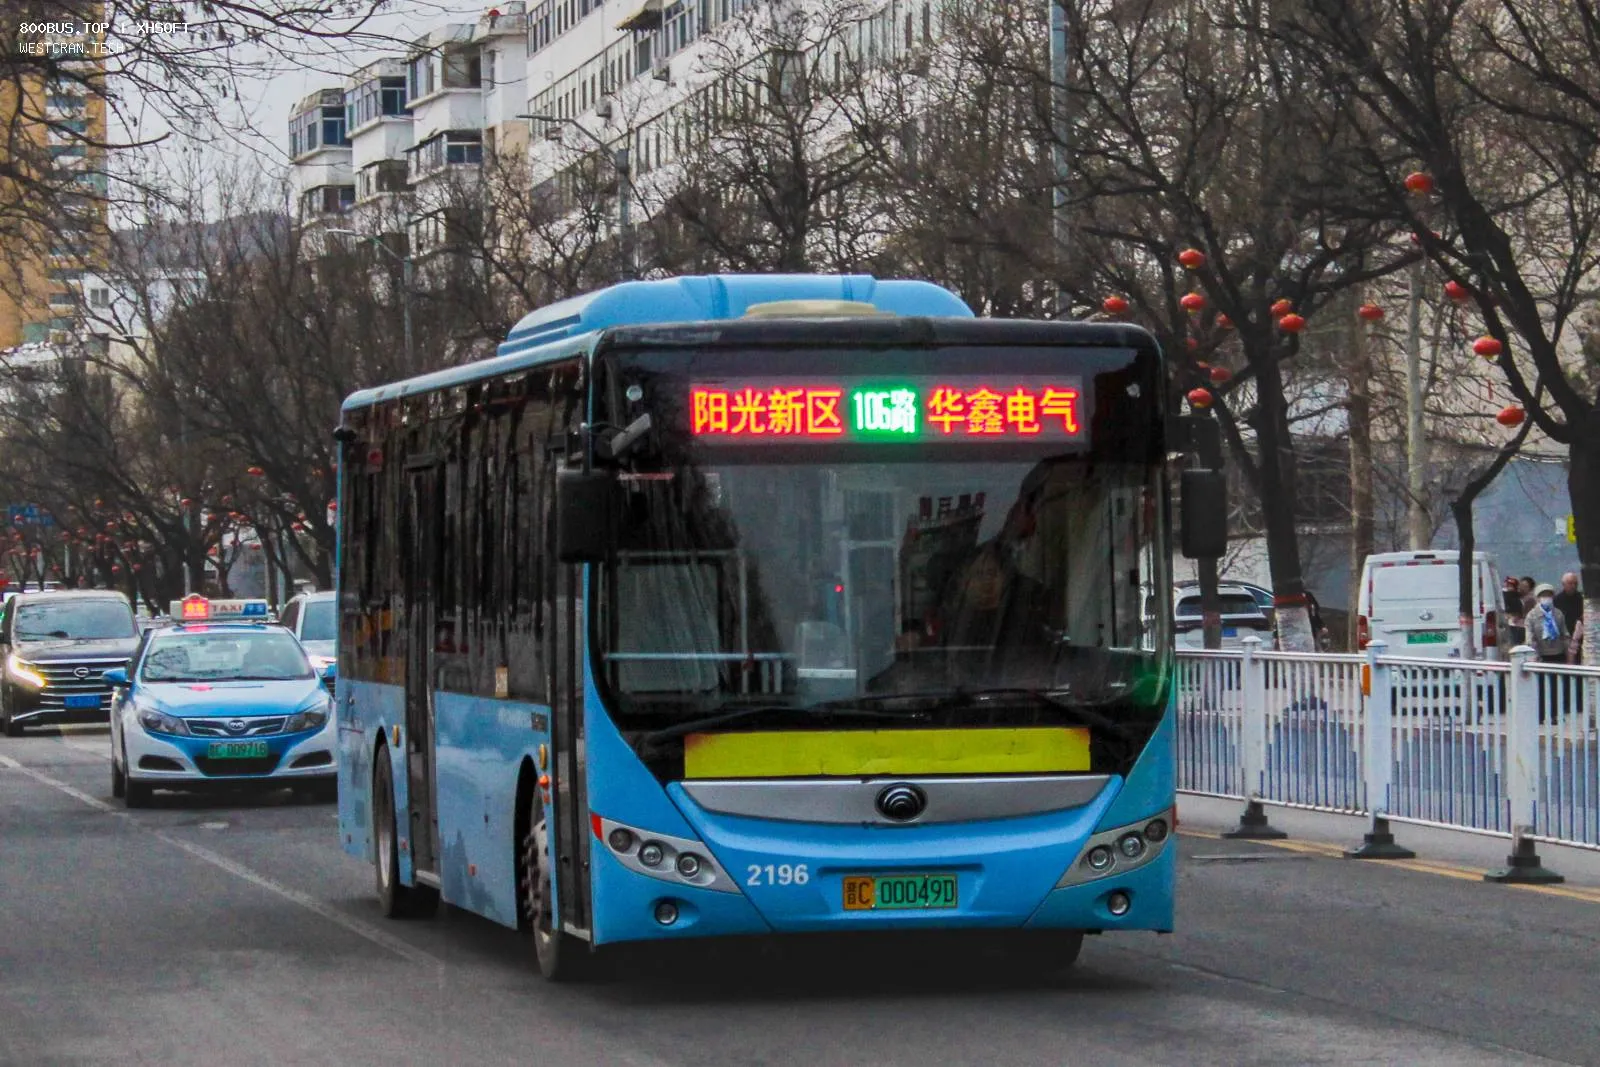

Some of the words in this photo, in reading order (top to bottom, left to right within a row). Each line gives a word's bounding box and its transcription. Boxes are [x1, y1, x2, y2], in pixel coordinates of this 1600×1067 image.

[692, 389, 843, 435] 阳光新区
[927, 388, 1078, 434] 华鑫电气
[212, 603, 242, 612] TAXI
[746, 863, 809, 886] 2196
